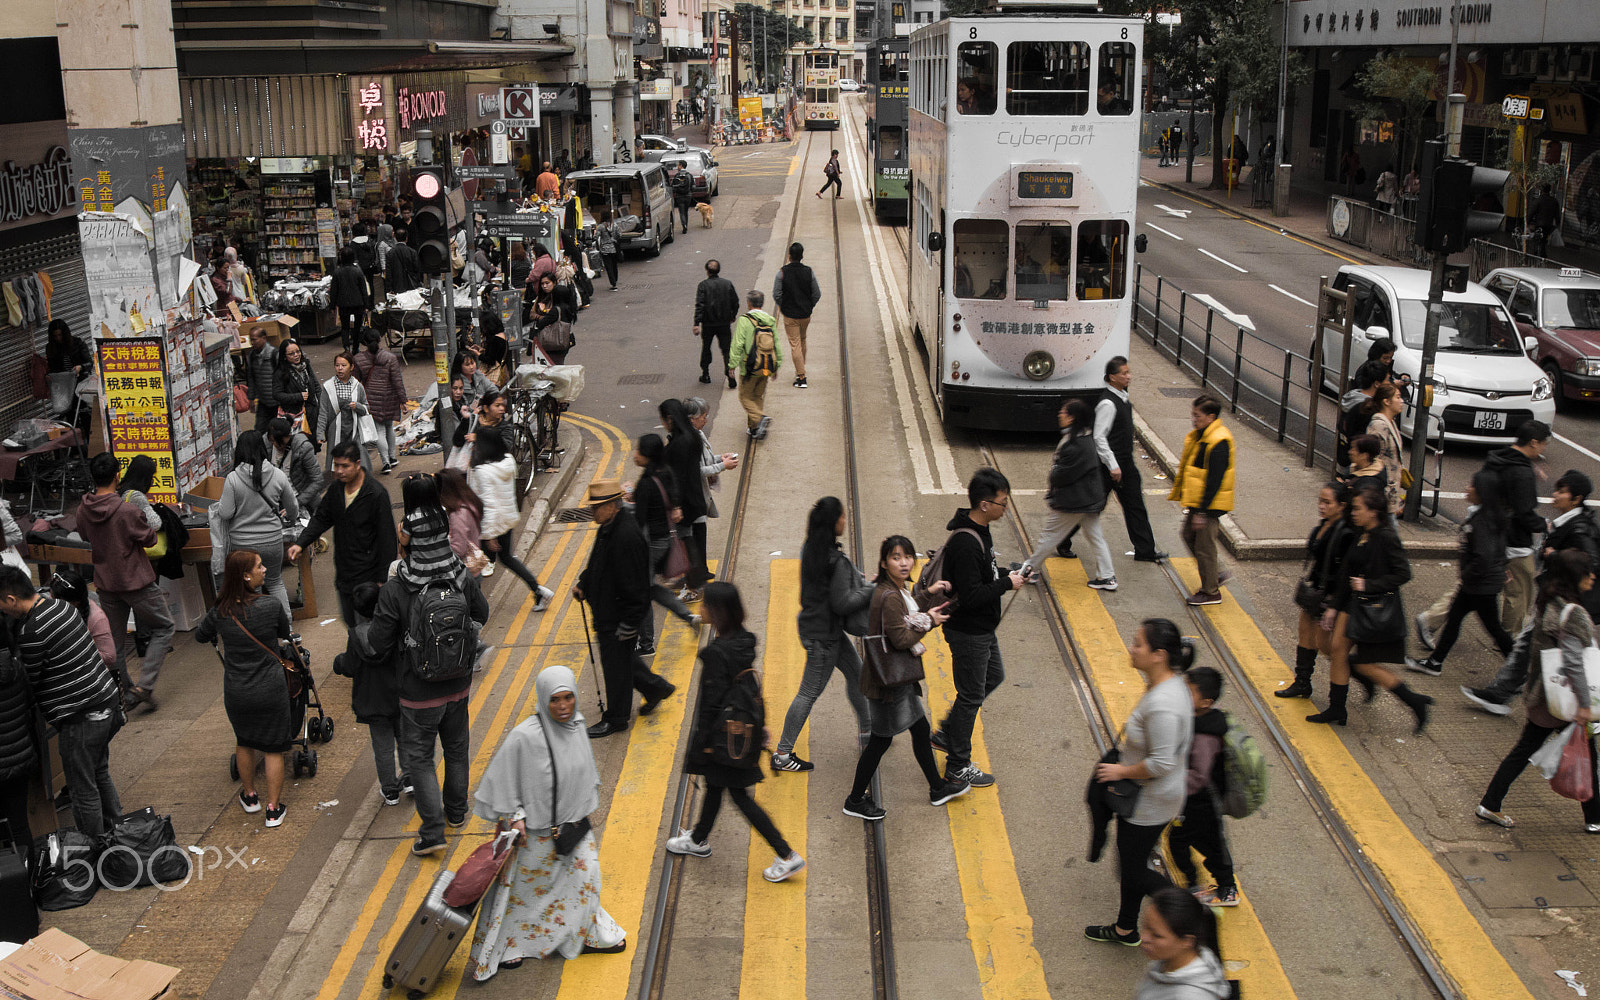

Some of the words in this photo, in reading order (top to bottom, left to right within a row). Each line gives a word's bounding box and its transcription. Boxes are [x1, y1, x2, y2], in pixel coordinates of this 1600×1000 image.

[1396, 7, 1442, 27] SOUTHORN
[1450, 3, 1492, 25] SADIUM
[969, 27, 978, 39] 8
[1120, 27, 1128, 39] 8
[538, 92, 557, 100] asa
[411, 90, 447, 123] BONJOUR
[1071, 124, 1094, 132] 數碼港
[997, 127, 1095, 152] Cyberport
[0, 145, 76, 223] 施餅店
[981, 321, 1095, 335] 數碼港創意微型基金
[102, 346, 160, 360] 天時稅務
[105, 361, 160, 369] 會計事務所
[107, 376, 162, 390] 稅務申報
[109, 396, 164, 409] 成立公司
[1484, 412, 1498, 420] UD
[1478, 420, 1502, 428] 1390
[112, 427, 169, 441] 天時稅務
[116, 442, 169, 450] 會計事務所
